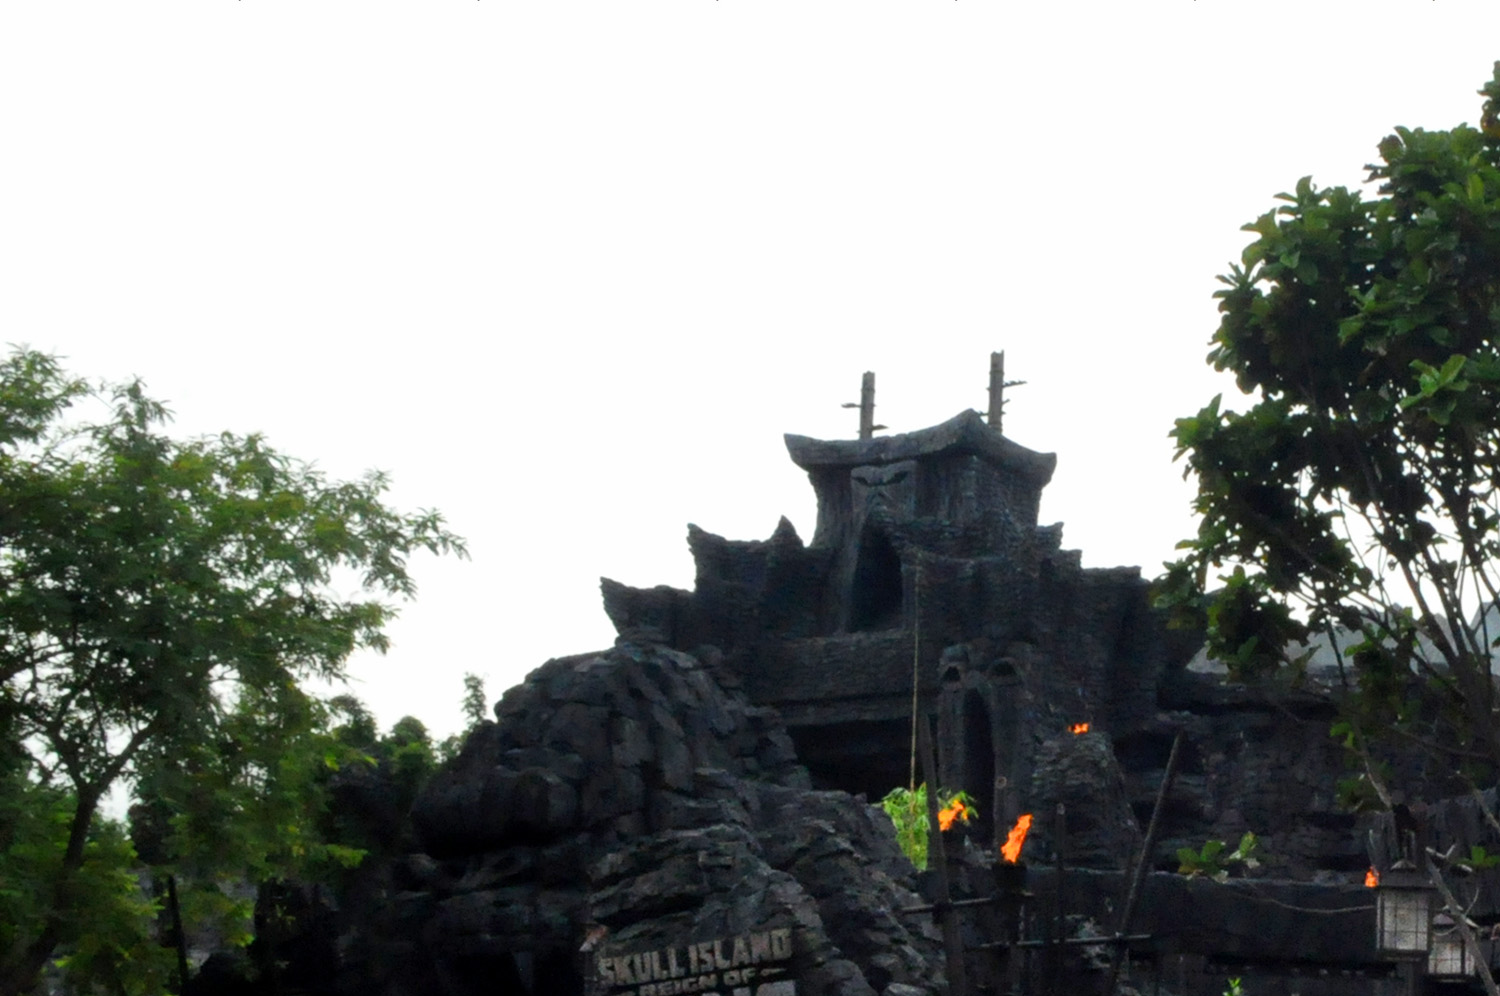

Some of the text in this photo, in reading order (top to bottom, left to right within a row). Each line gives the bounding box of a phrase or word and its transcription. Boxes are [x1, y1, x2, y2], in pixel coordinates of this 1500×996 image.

[599, 928, 792, 986] SKULL ISLAND
[723, 967, 757, 987] OF
